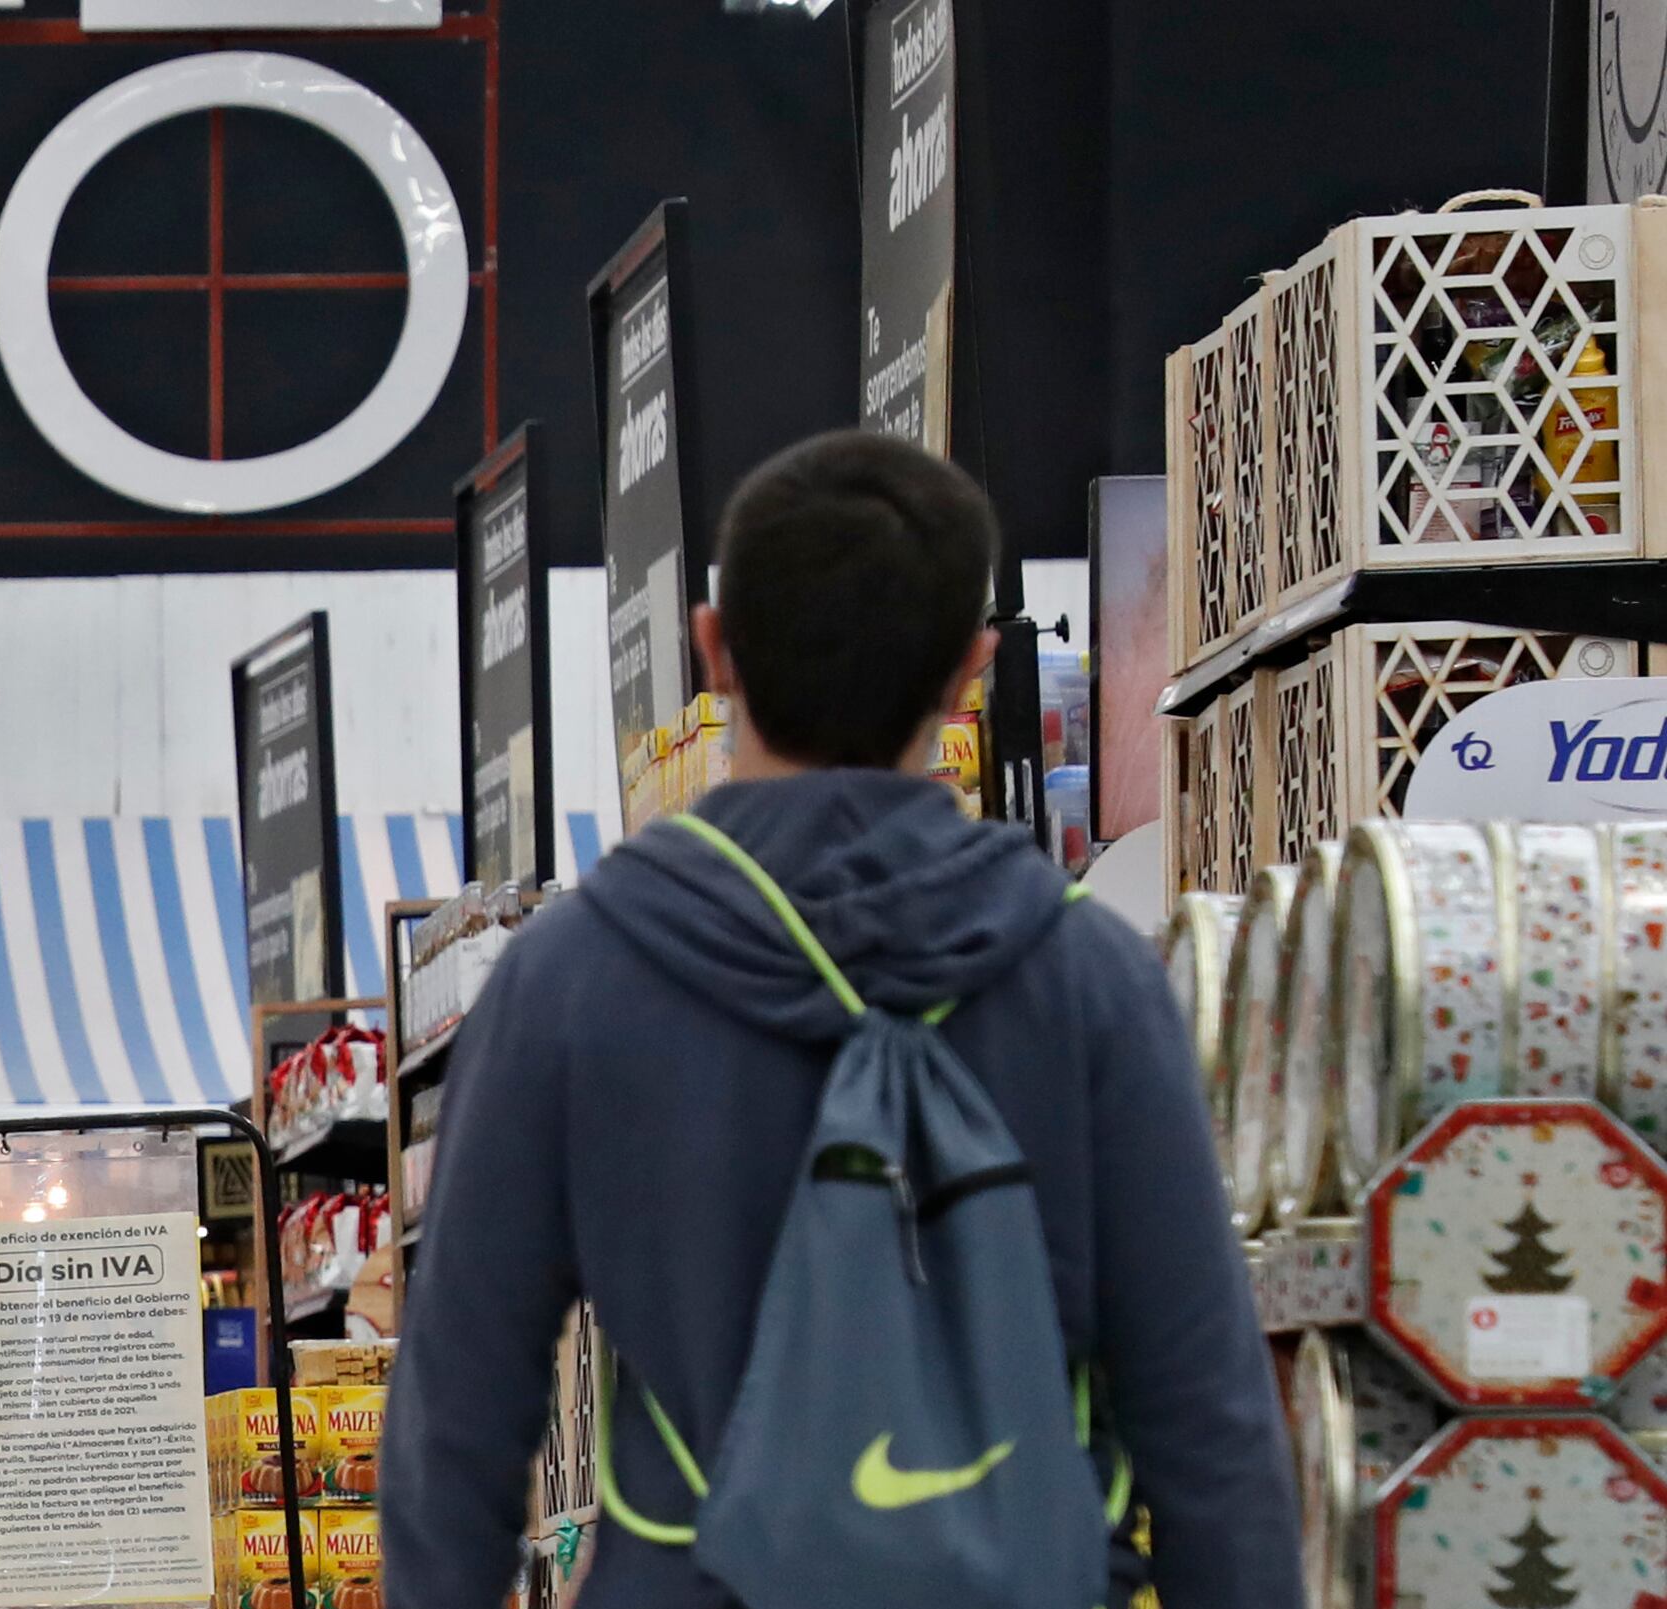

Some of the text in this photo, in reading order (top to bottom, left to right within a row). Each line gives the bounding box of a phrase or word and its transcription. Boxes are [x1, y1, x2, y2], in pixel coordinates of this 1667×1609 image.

[868, 306, 881, 358] Te
[620, 389, 667, 495] ahorras
[1547, 715, 1667, 783] Yod
[40, 1232, 57, 1242] de
[60, 1227, 122, 1242] exención
[124, 1226, 141, 1238] de
[144, 1225, 169, 1236] IVA
[51, 1257, 93, 1281] sin
[102, 1254, 154, 1278] IVA
[42, 1299, 54, 1309] el
[56, 1297, 111, 1309] beneficio
[113, 1294, 132, 1305] del
[135, 1292, 190, 1304] Gobierno
[64, 1312, 79, 1322] de
[81, 1309, 146, 1322] noviembre
[148, 1306, 187, 1318] debes:
